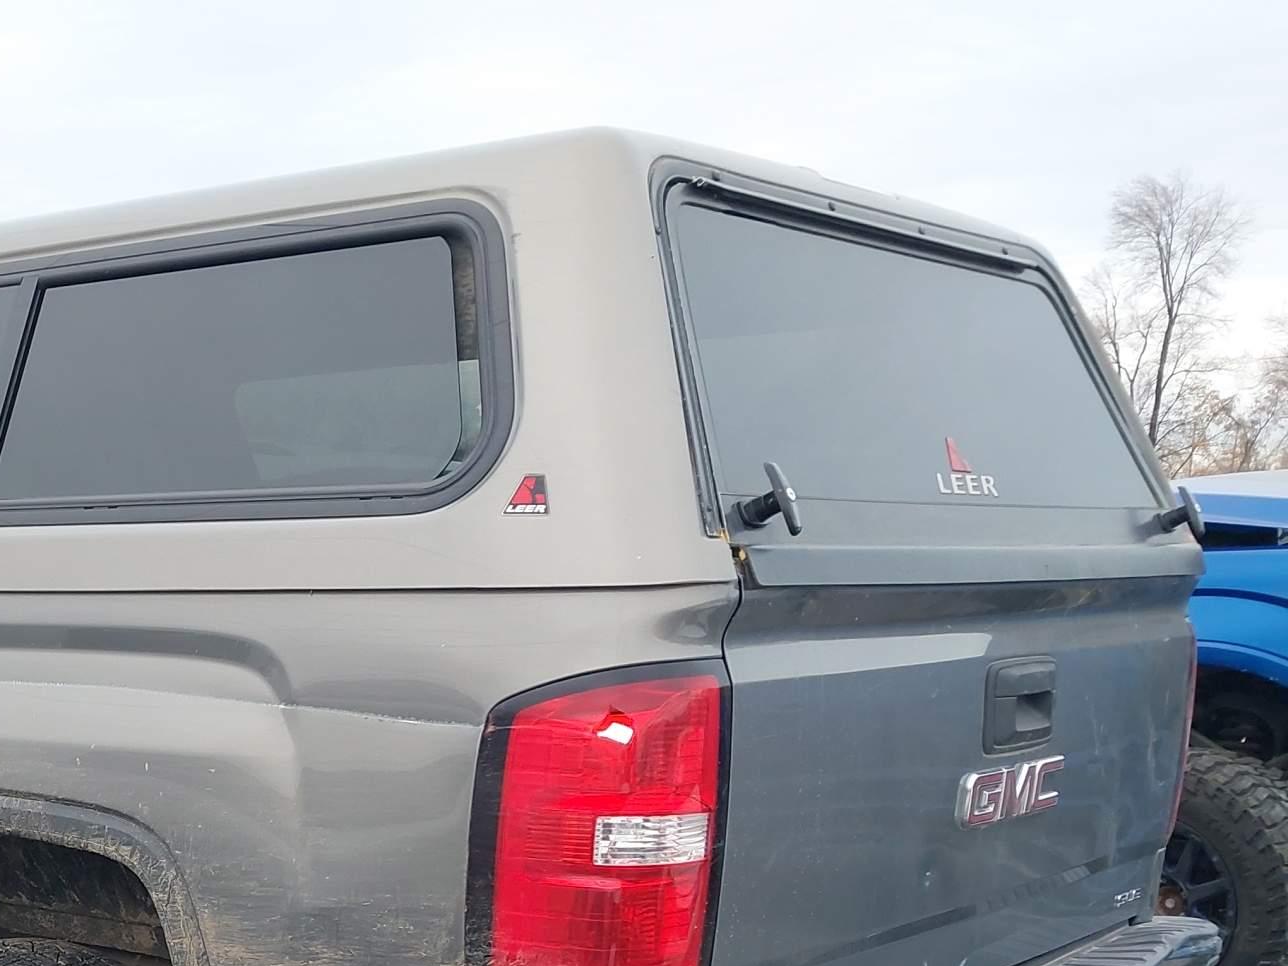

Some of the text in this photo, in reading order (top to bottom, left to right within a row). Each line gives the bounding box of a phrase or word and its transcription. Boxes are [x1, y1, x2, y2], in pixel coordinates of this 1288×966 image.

[936, 472, 999, 497] LEER
[505, 504, 547, 513] LEER
[958, 755, 1065, 828] GMC
